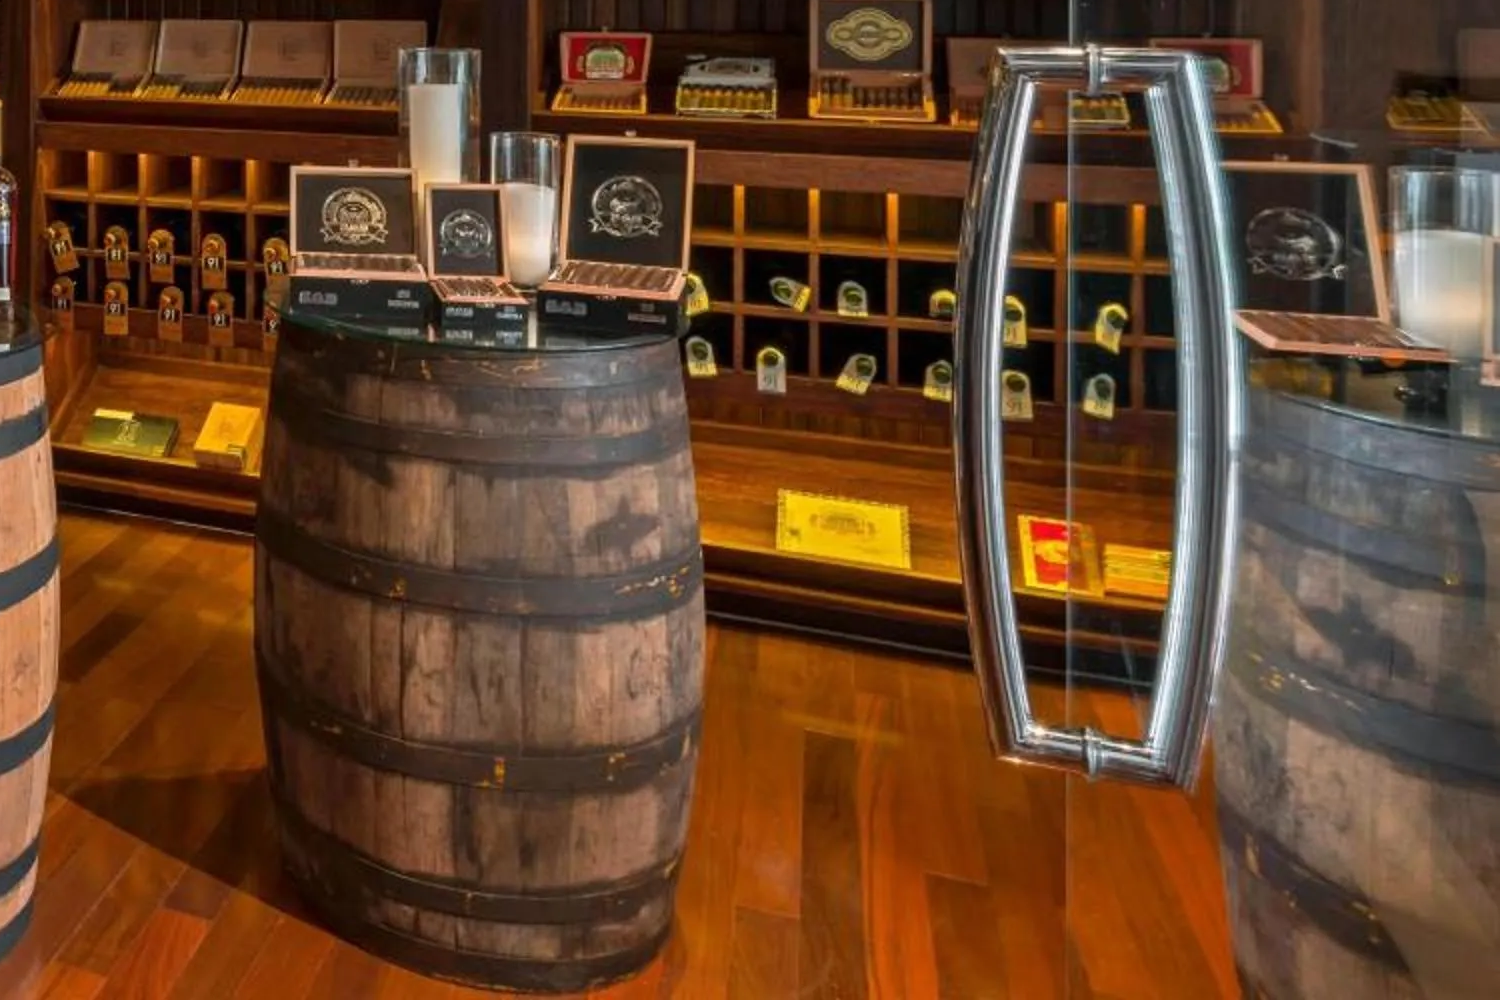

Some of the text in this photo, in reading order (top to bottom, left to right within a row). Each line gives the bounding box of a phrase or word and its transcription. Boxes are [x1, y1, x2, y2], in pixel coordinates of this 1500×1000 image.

[206, 256, 219, 270] 91
[108, 302, 121, 315] 91
[163, 308, 175, 321] 91
[214, 313, 226, 327] 91
